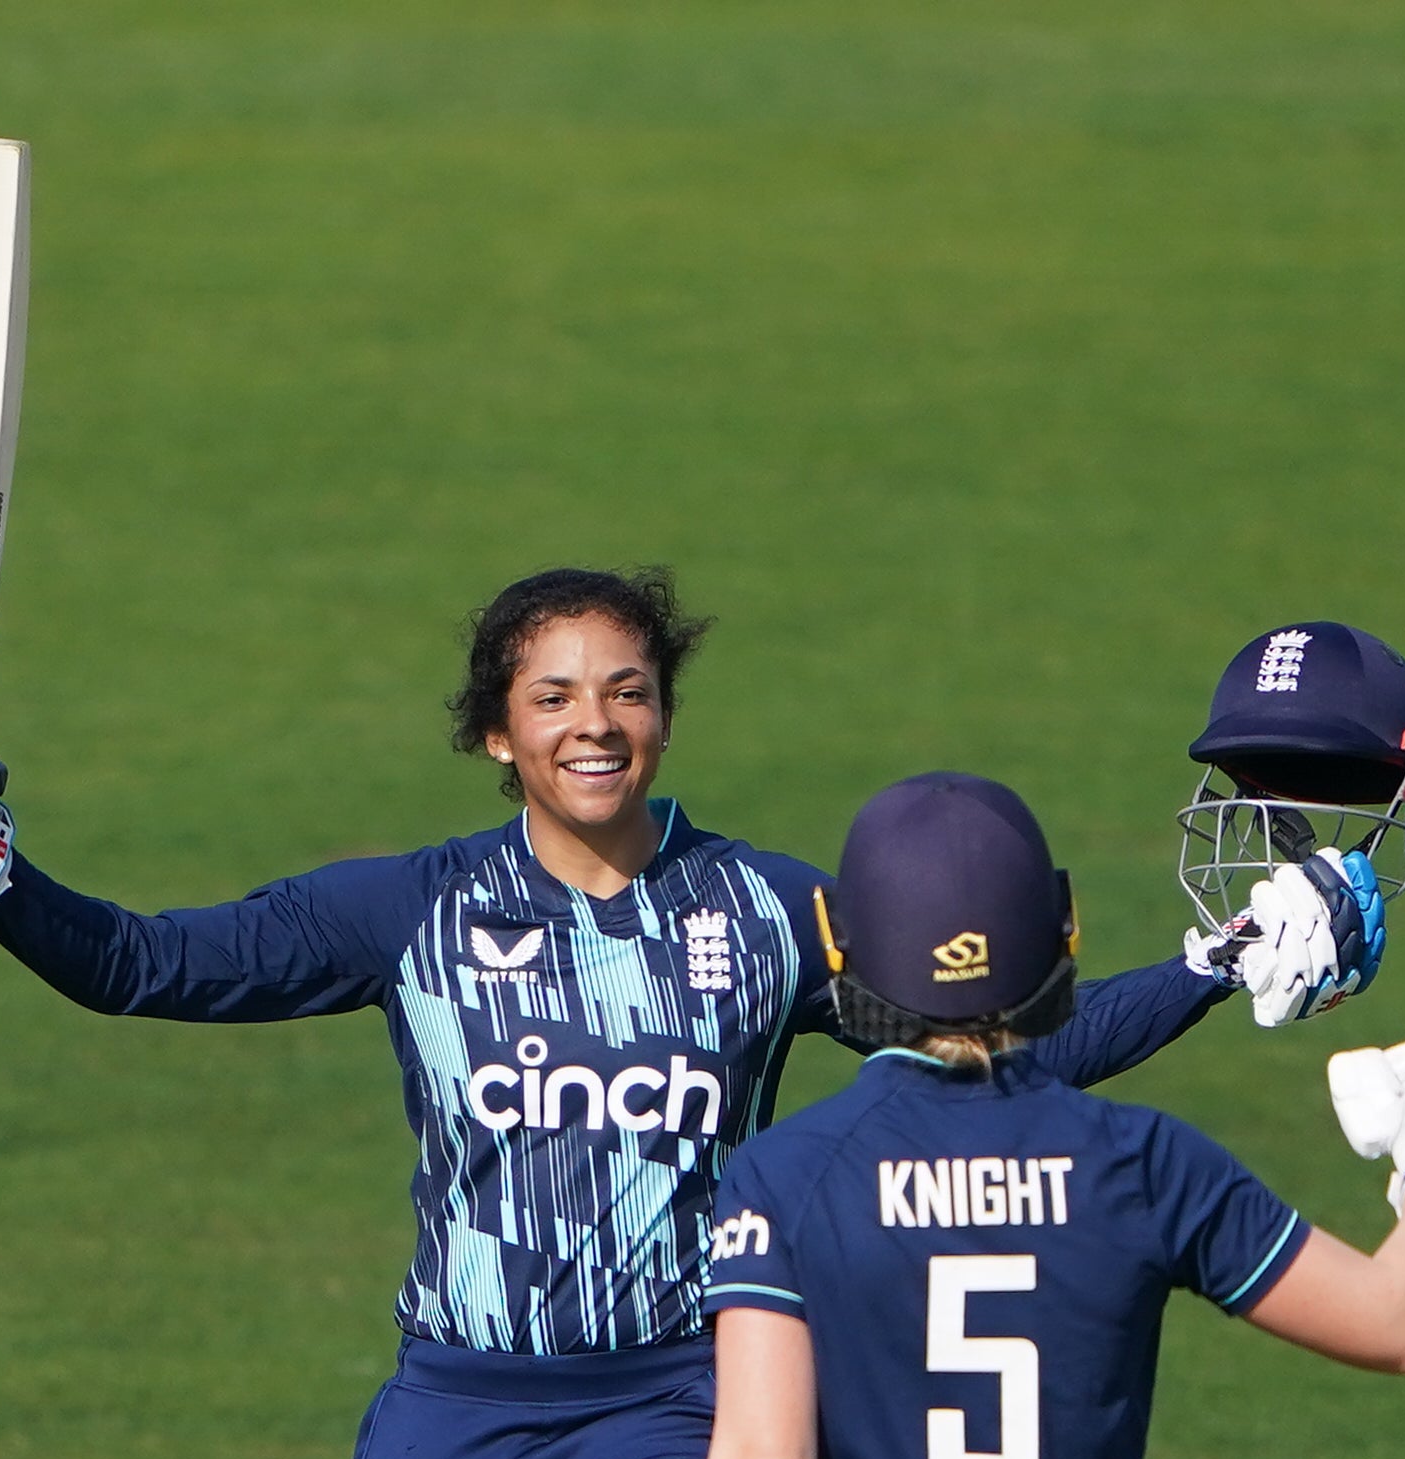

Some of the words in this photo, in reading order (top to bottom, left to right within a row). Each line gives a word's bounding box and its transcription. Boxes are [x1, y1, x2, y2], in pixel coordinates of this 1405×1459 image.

[471, 970, 537, 983] CASTORE
[468, 1036, 722, 1135] cinch
[878, 1157, 1073, 1228] KNIGHT
